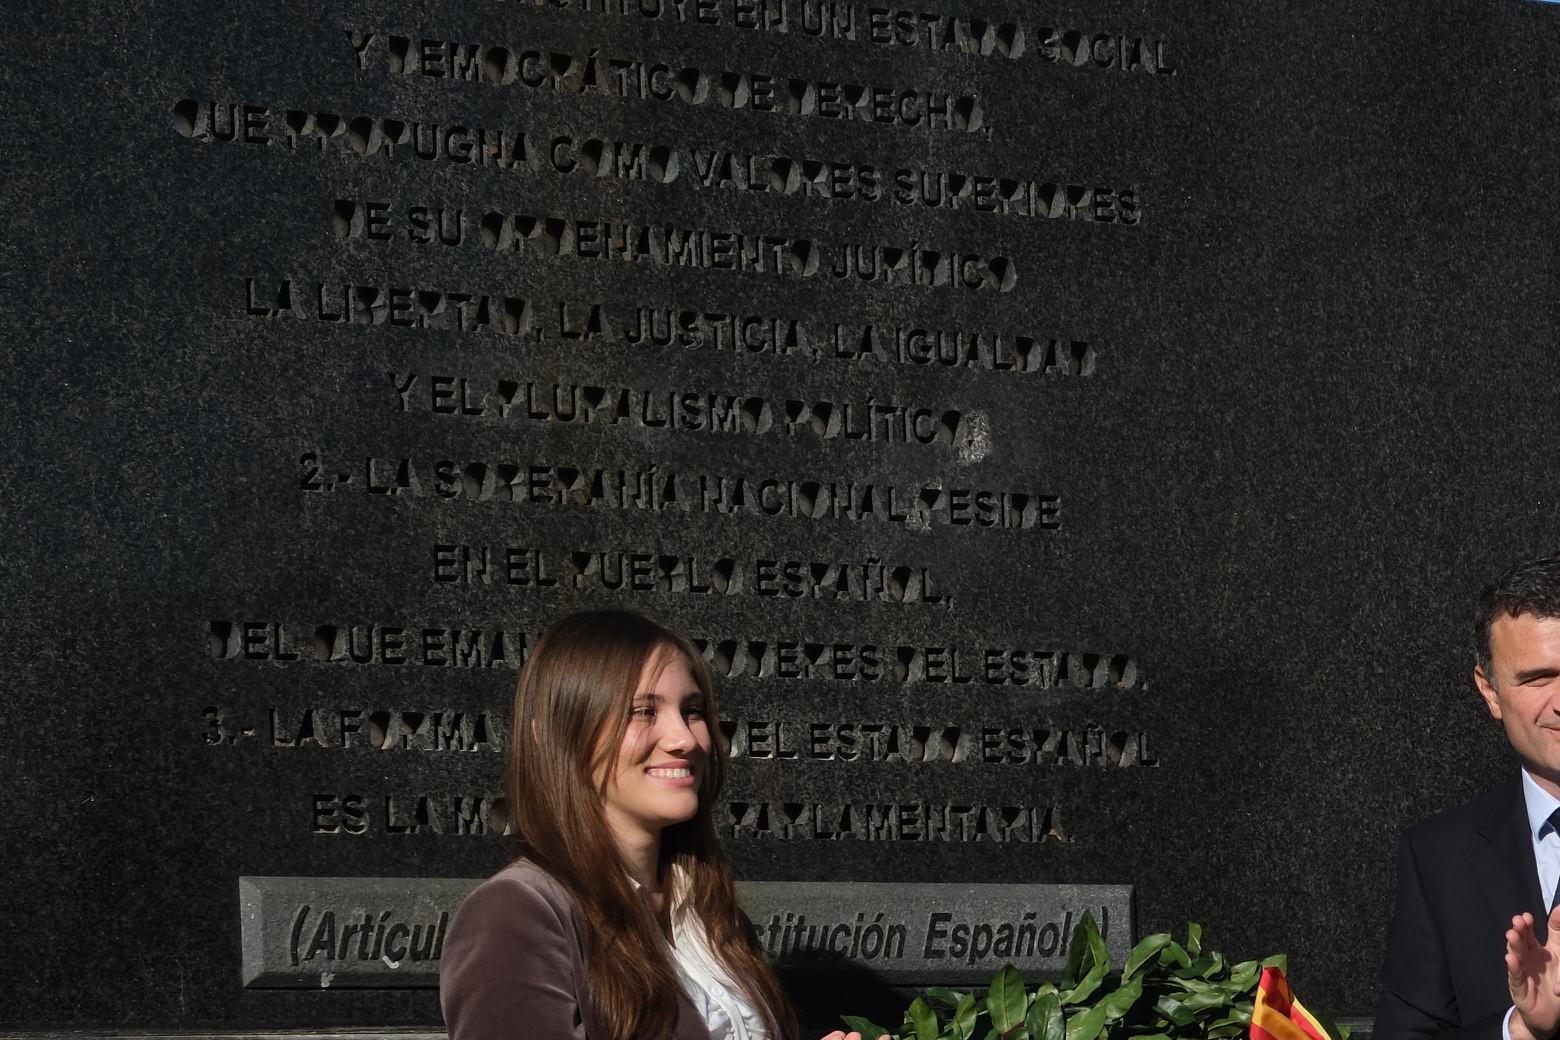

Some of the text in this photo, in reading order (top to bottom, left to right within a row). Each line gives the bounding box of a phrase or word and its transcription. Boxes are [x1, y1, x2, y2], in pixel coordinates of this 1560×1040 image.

[735, 0, 788, 33] EN
[802, 2, 856, 41] UN
[870, 8, 1026, 60] ESTADO
[1037, 26, 1177, 76] SOCIAL
[344, 29, 993, 141] Y DEMOCRÁTICO DE DERECHO,
[174, 99, 1142, 226] QUE PROPUGNA COMO VALORES SUPERIORES
[334, 199, 1018, 293] DE SU ORDENAMIENTO JURÍDICO
[246, 277, 1096, 377] LA LIBERTAD, LA JUSTICIA, LA IGUALDAD
[389, 373, 417, 412] Y
[432, 375, 485, 416] EL
[498, 379, 774, 436] PLURALISMO
[367, 455, 424, 498] LA
[434, 460, 691, 514] SOBERANÍA
[700, 475, 908, 523] NACIONAL
[917, 486, 1063, 530] RESIDE
[434, 544, 955, 612] EN EL PUEBLO ESPAÑOL,
[210, 619, 299, 662] DEL
[314, 624, 408, 665] QUE
[896, 646, 973, 685] DEL
[269, 708, 329, 749] LA
[340, 709, 502, 752] FORMA
[719, 720, 1161, 768] DEL ESTADO ESPAÑOL
[312, 794, 369, 836] ES
[385, 796, 439, 835] LA
[290, 905, 447, 968] (Artícul
[753, 906, 1109, 965] titución Español)
